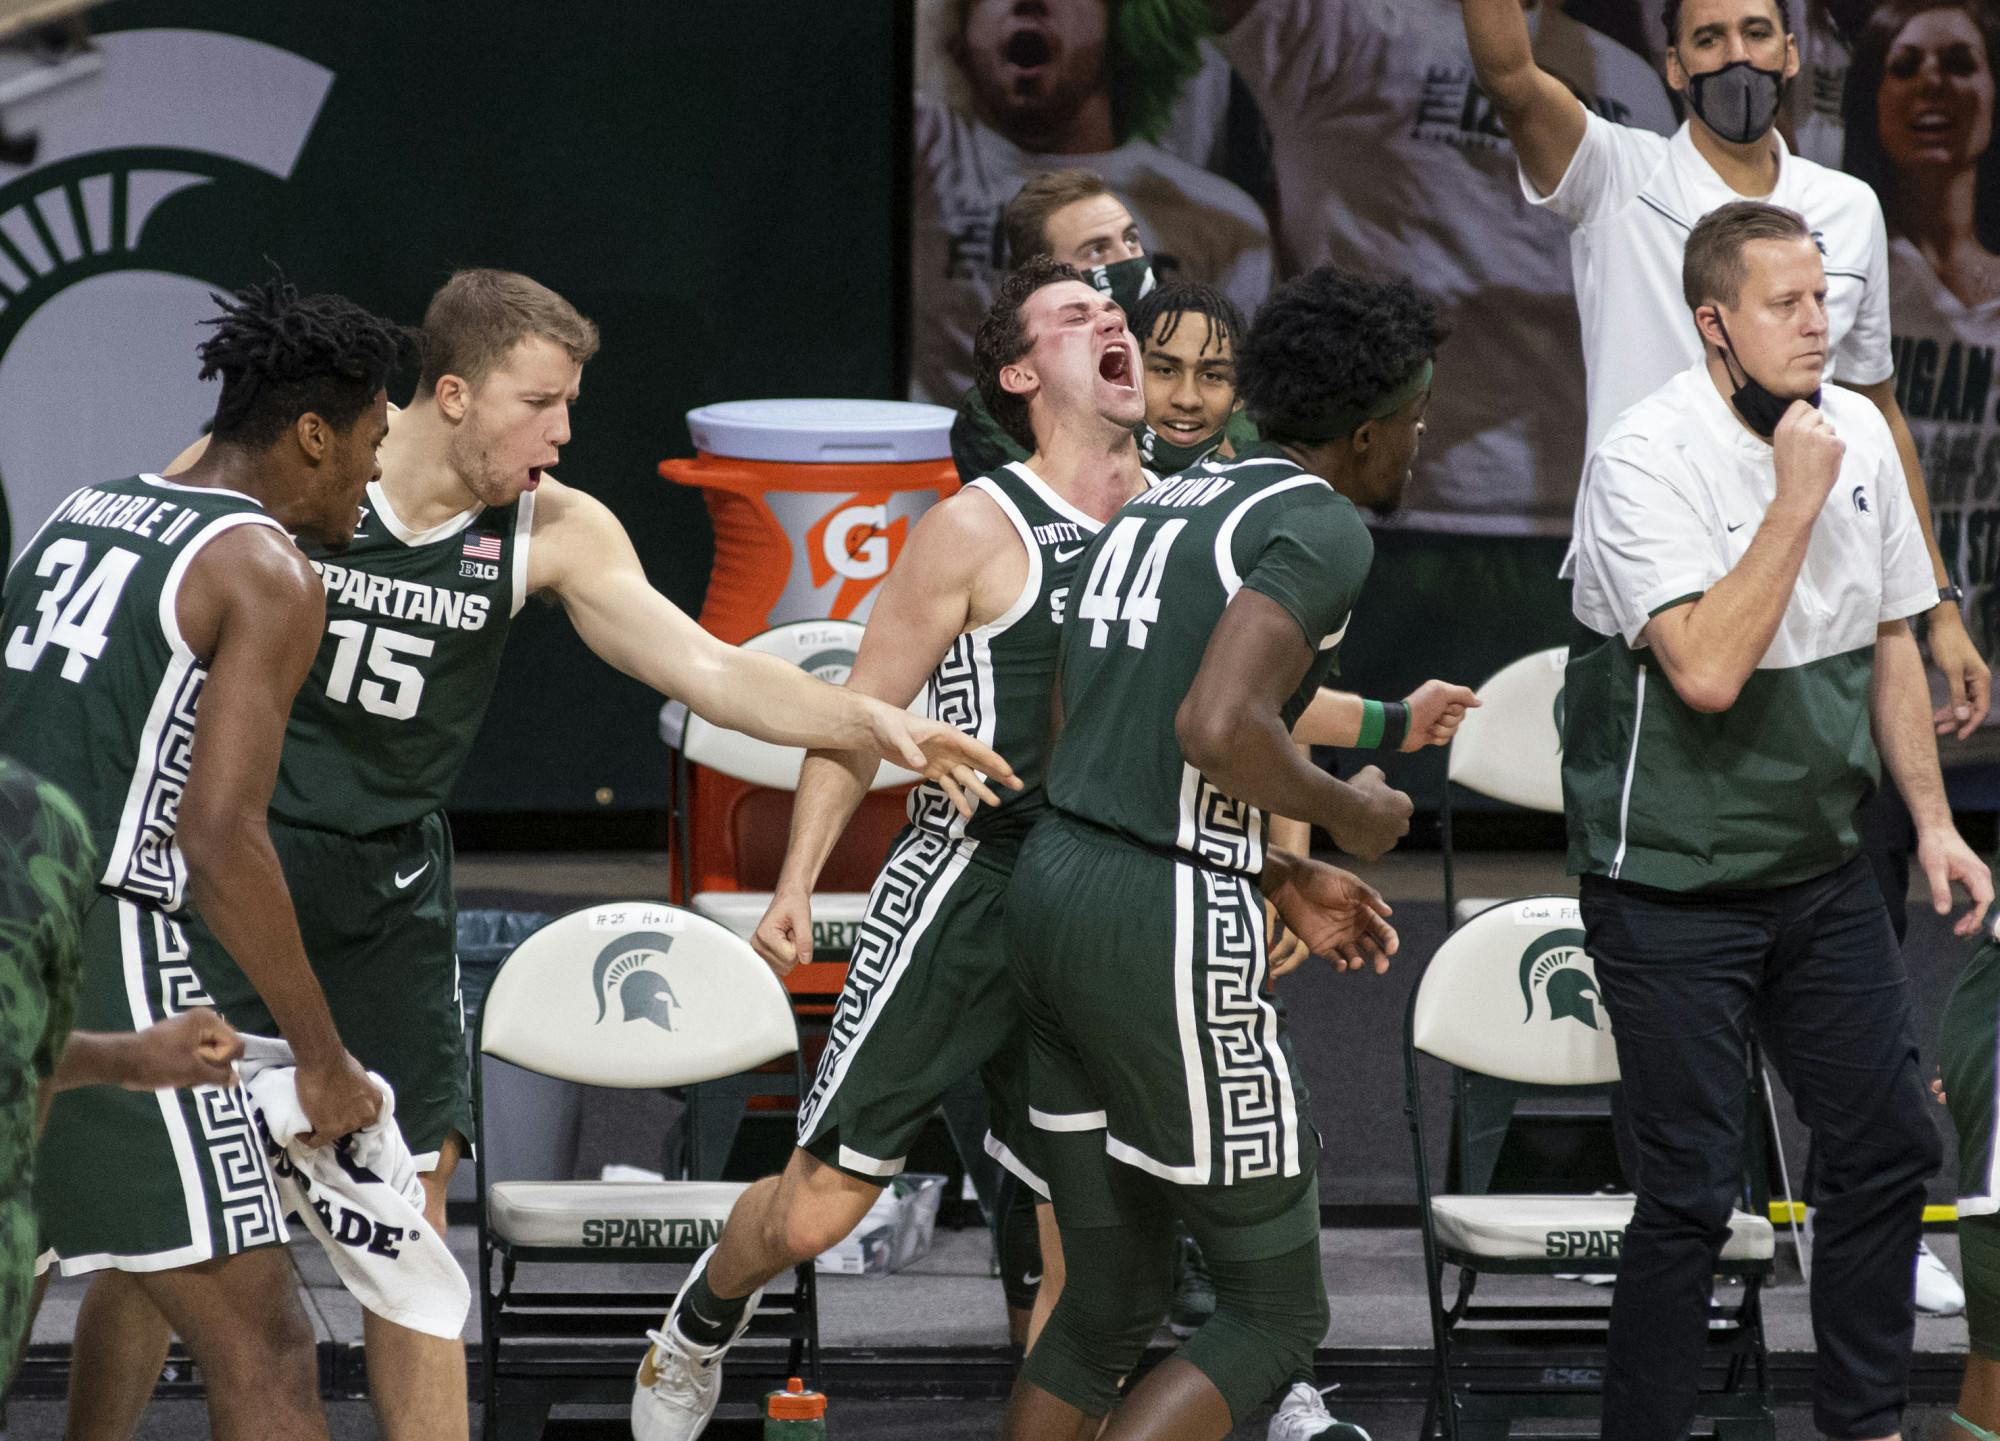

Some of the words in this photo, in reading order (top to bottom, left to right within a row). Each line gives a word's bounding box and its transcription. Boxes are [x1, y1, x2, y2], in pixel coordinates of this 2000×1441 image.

[57, 487, 178, 538] MARBLE
[823, 504, 889, 580] G
[1033, 521, 1083, 546] UNITY
[4, 537, 141, 684] 34
[1078, 516, 1189, 650] 44
[325, 619, 436, 721] 15
[642, 911, 675, 925] Hall
[1522, 906, 1551, 919] Coach
